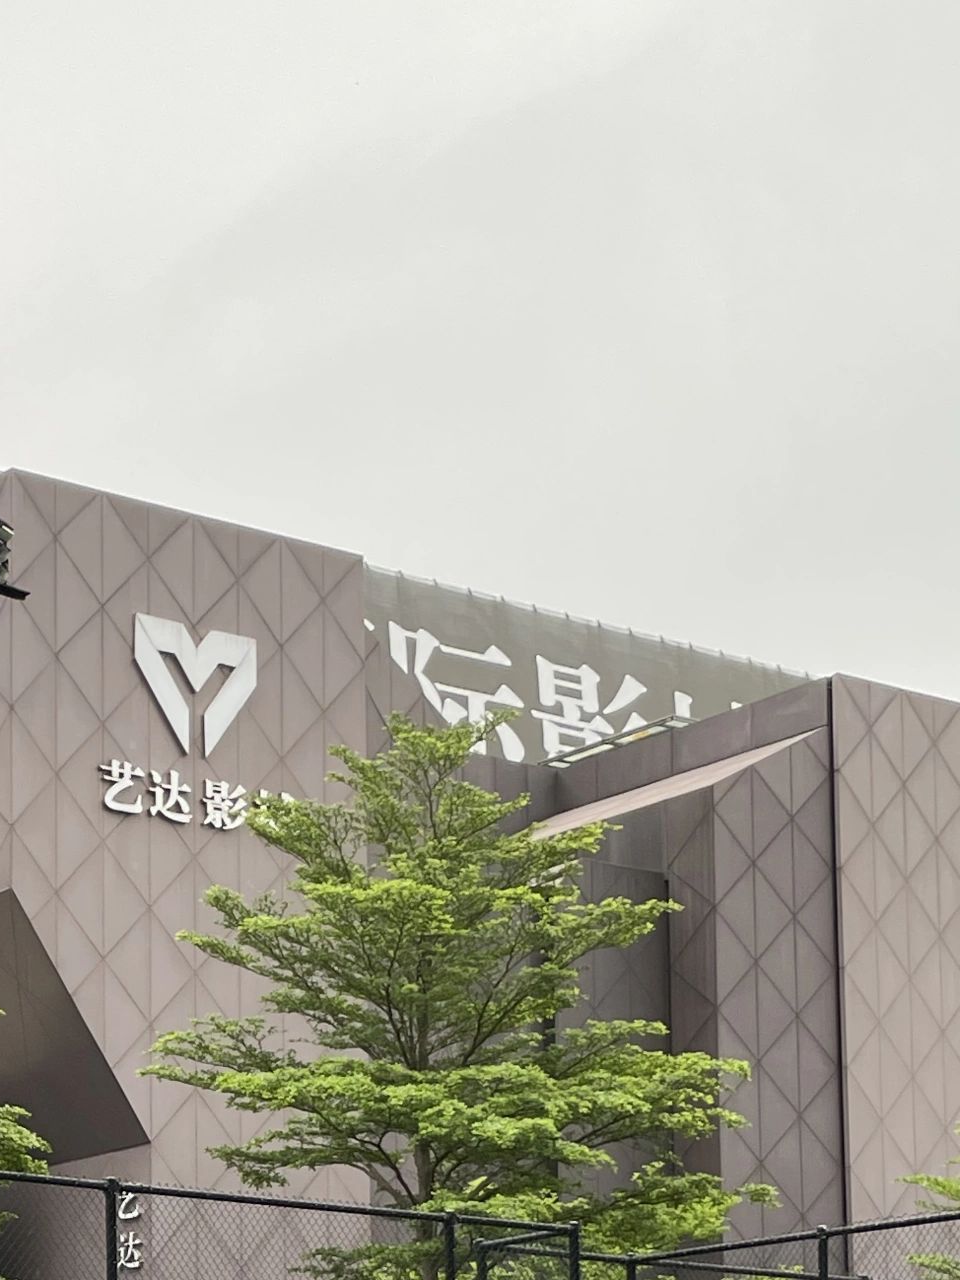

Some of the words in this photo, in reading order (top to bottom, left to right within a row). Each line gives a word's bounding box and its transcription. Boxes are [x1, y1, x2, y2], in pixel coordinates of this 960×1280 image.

[363, 618, 742, 767] 际影
[98, 759, 295, 830] 艺达影
